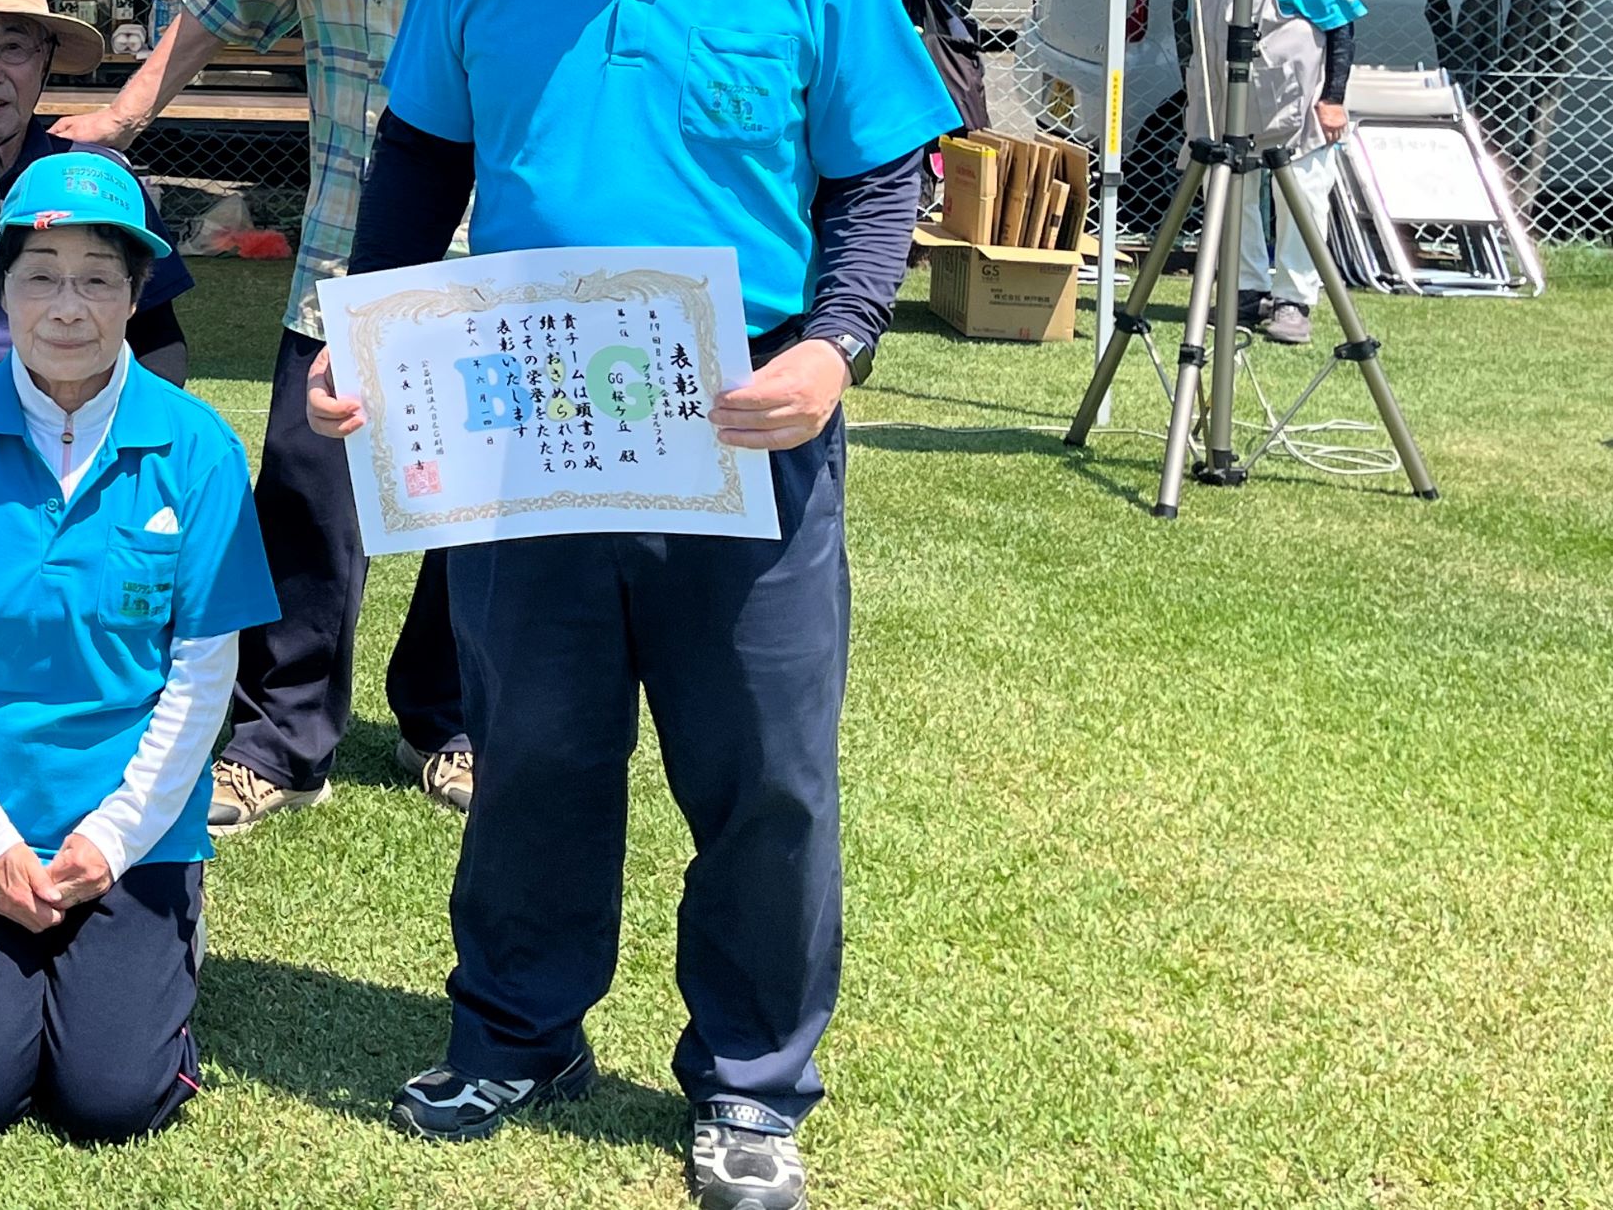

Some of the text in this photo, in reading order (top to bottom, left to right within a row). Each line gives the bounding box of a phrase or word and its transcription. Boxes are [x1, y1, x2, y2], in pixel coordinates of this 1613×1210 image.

[981, 264, 1000, 277] GS
[497, 318, 528, 438] 表彰いたします
[519, 315, 556, 472] でその栄誉をたたえ
[539, 313, 577, 470] 績をおさめられたの
[562, 312, 603, 471] 貴チームは頭書の成
[669, 343, 706, 421] 表彰状
[618, 450, 639, 464] 殿
